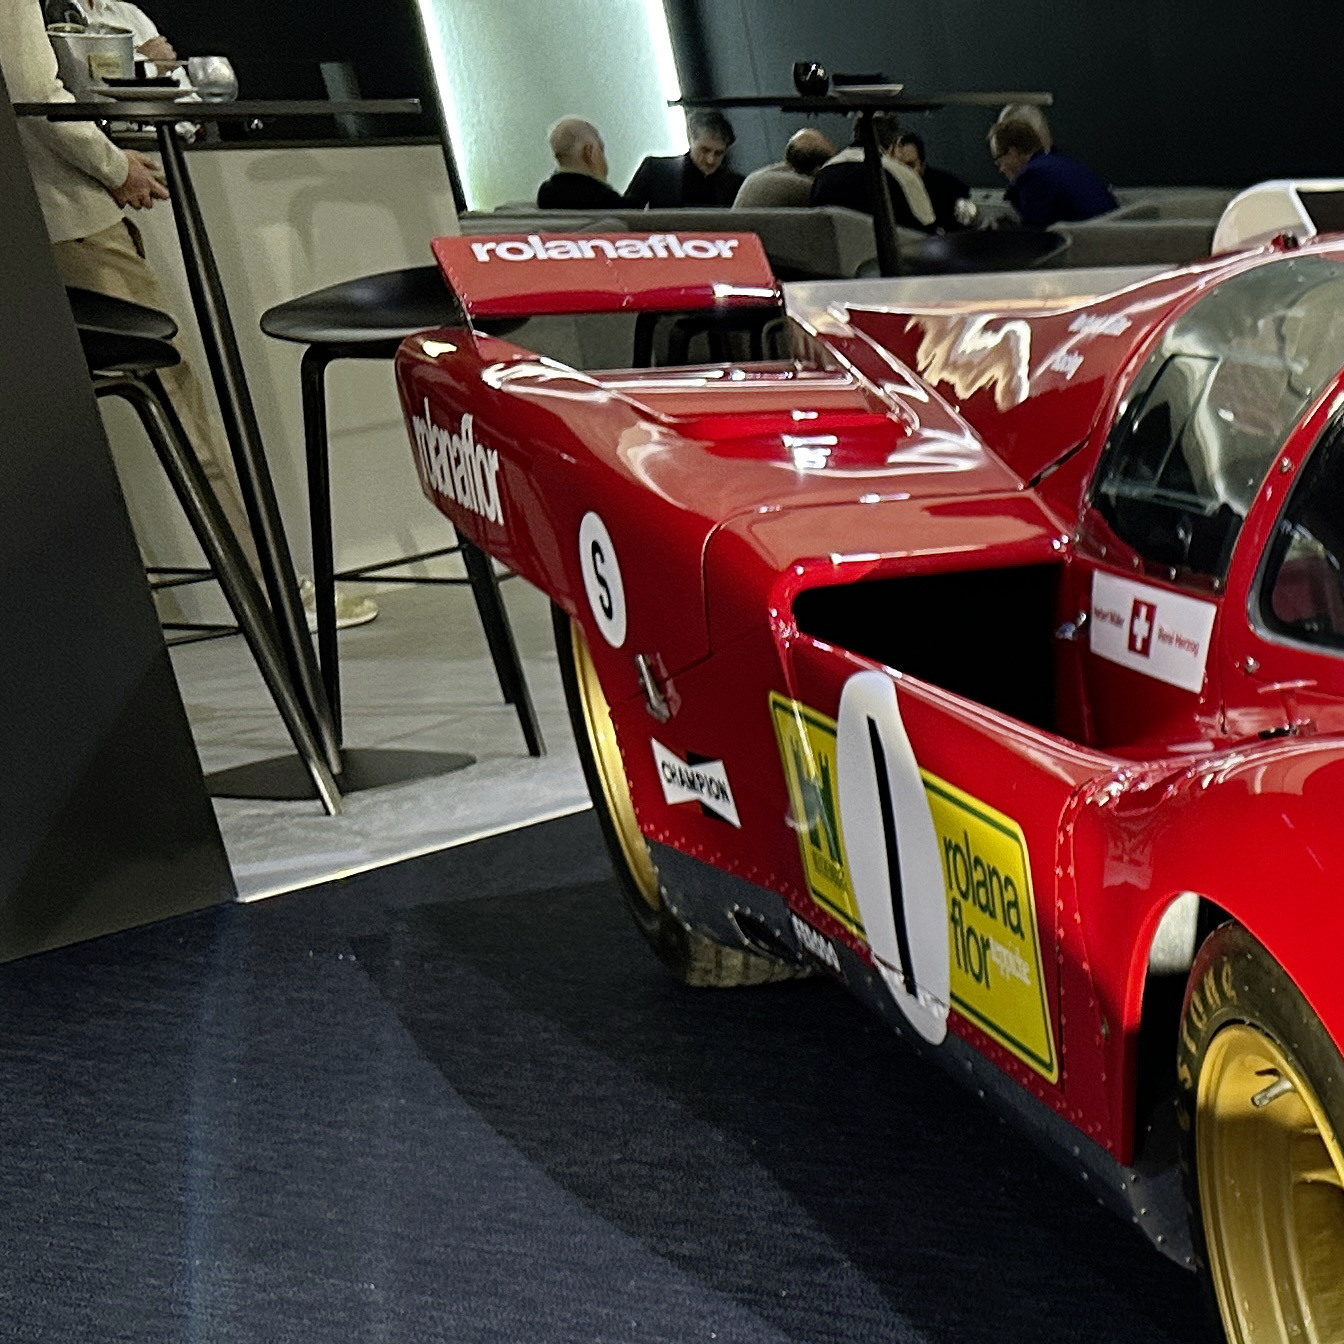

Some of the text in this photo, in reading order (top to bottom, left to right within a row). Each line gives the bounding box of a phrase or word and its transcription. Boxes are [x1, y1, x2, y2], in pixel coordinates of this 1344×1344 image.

[471, 234, 739, 263] rolanaflor
[412, 396, 504, 526] rolanaflor
[591, 540, 613, 621] S
[661, 760, 731, 806] CHAMPION
[943, 829, 1026, 941] rolana
[950, 897, 991, 990] flor
